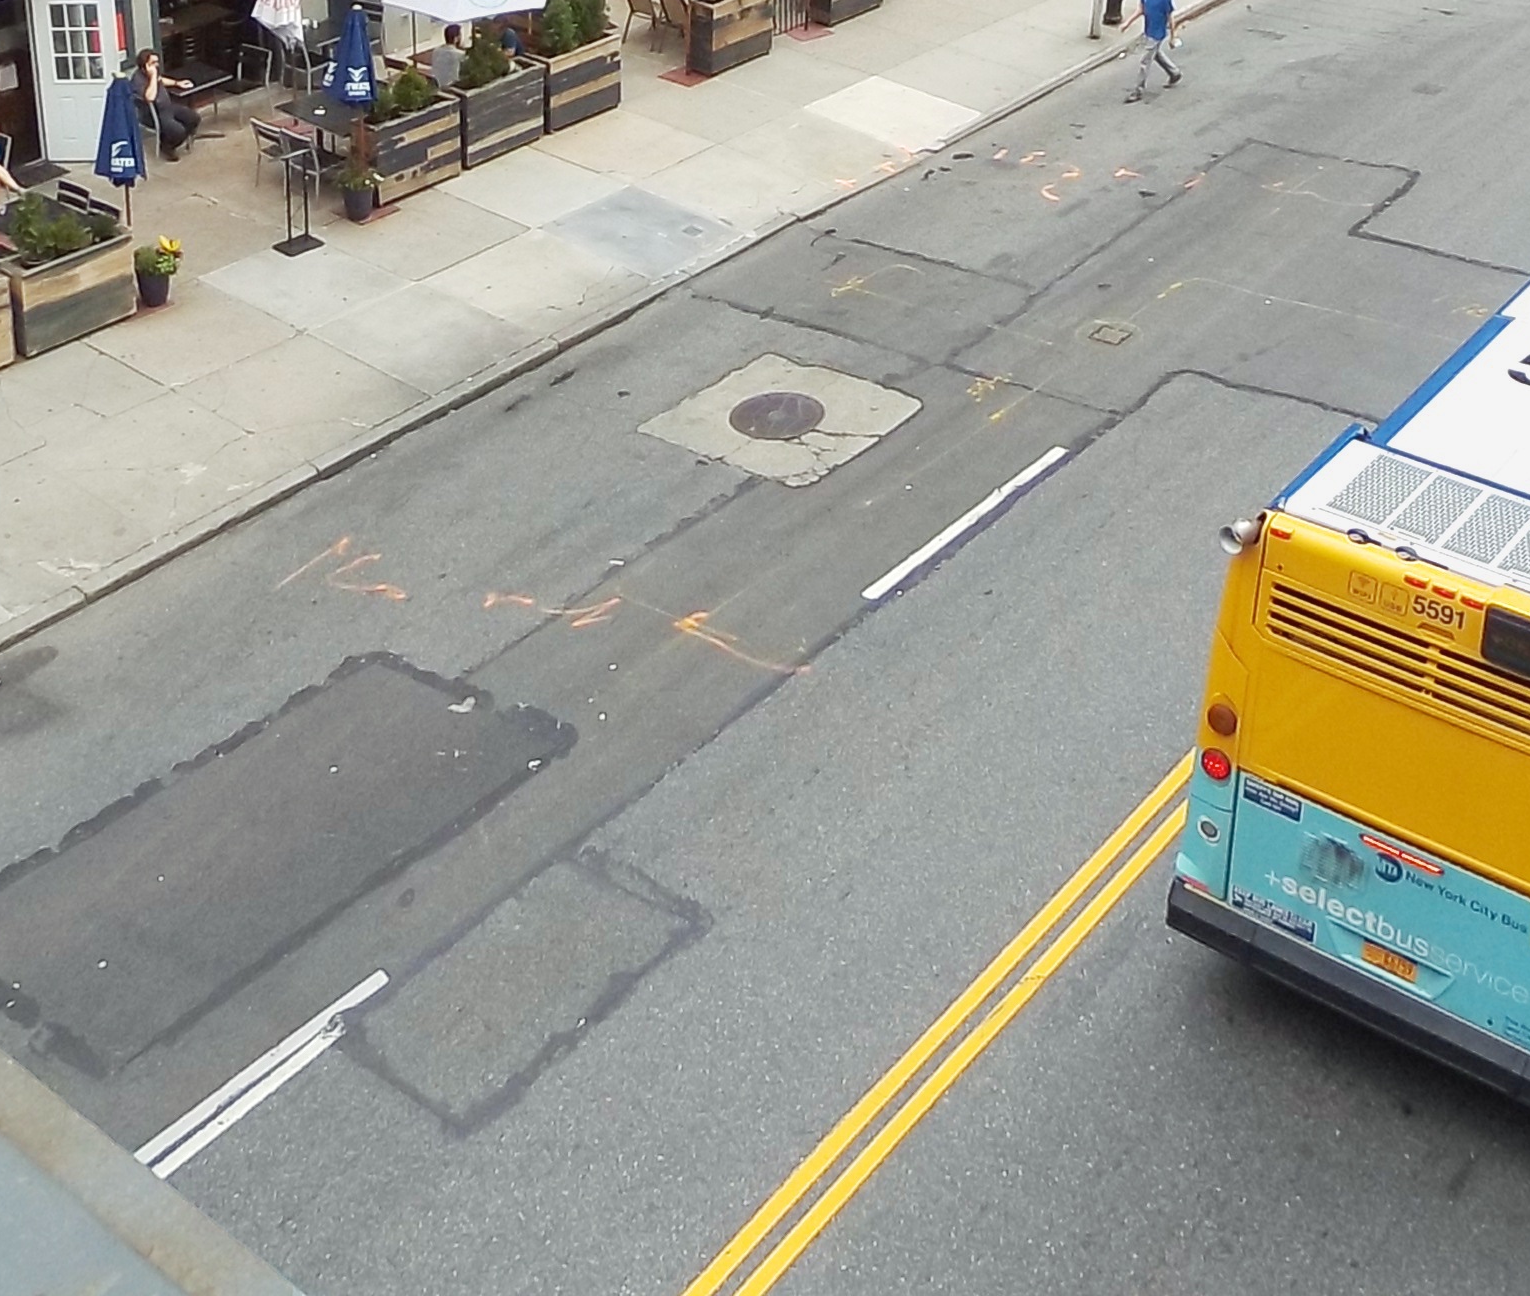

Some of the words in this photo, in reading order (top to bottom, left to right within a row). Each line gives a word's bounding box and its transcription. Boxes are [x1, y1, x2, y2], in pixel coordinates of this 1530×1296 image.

[1412, 594, 1465, 630] 5591
[1405, 871, 1435, 892] New
[1438, 884, 1467, 907] York
[1469, 900, 1499, 923] City
[1501, 913, 1528, 934] Bus
